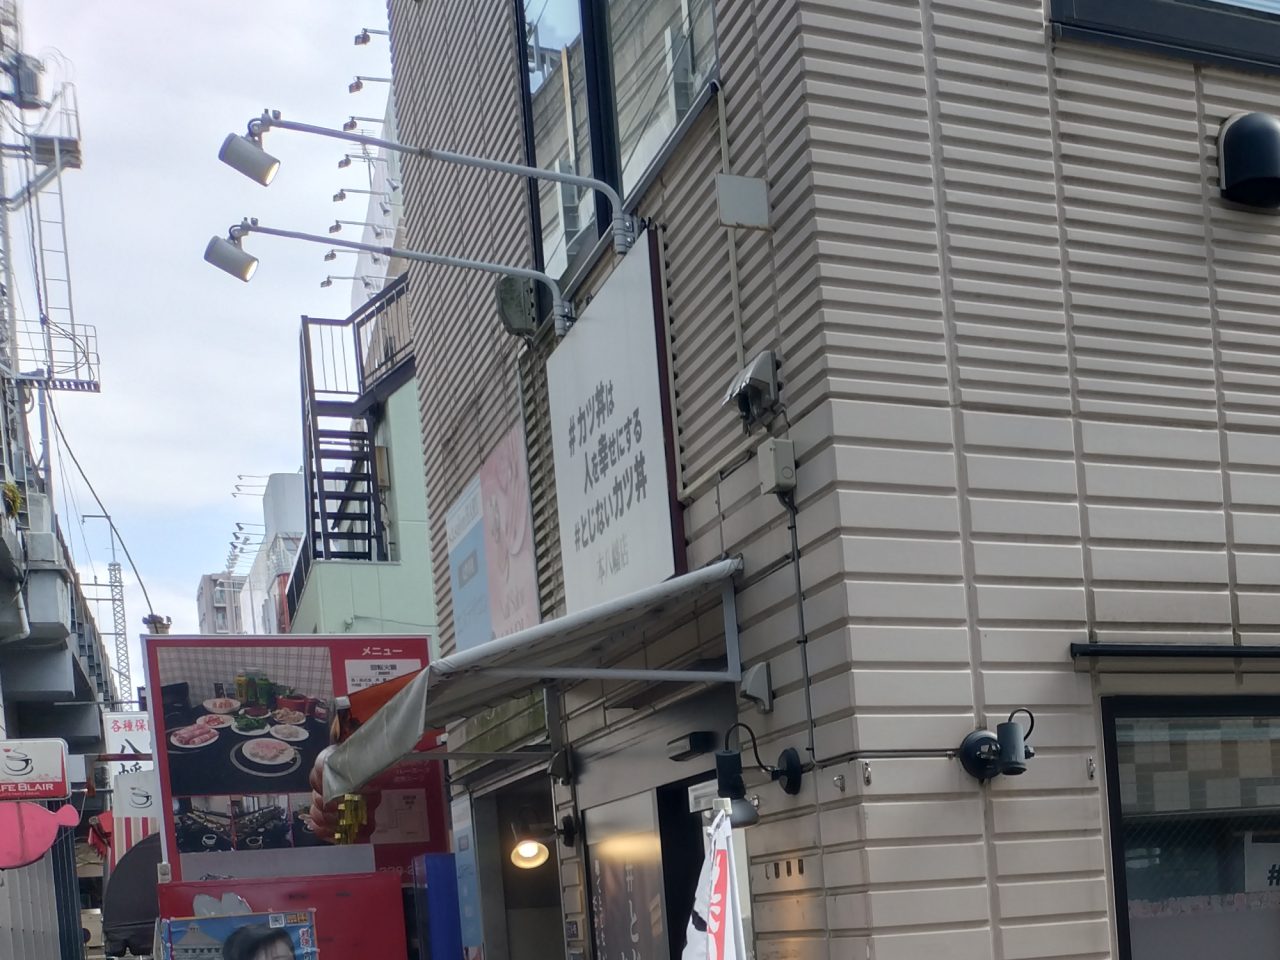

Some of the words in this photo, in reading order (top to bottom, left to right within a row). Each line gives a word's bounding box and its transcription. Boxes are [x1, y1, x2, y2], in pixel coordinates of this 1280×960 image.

[583, 406, 642, 495] 人を幸せにする
[574, 450, 648, 552] #とじないカツ丼
[361, 646, 403, 656] メニュー
[111, 719, 150, 732] 各種保
[17, 783, 54, 792] BLAIR
